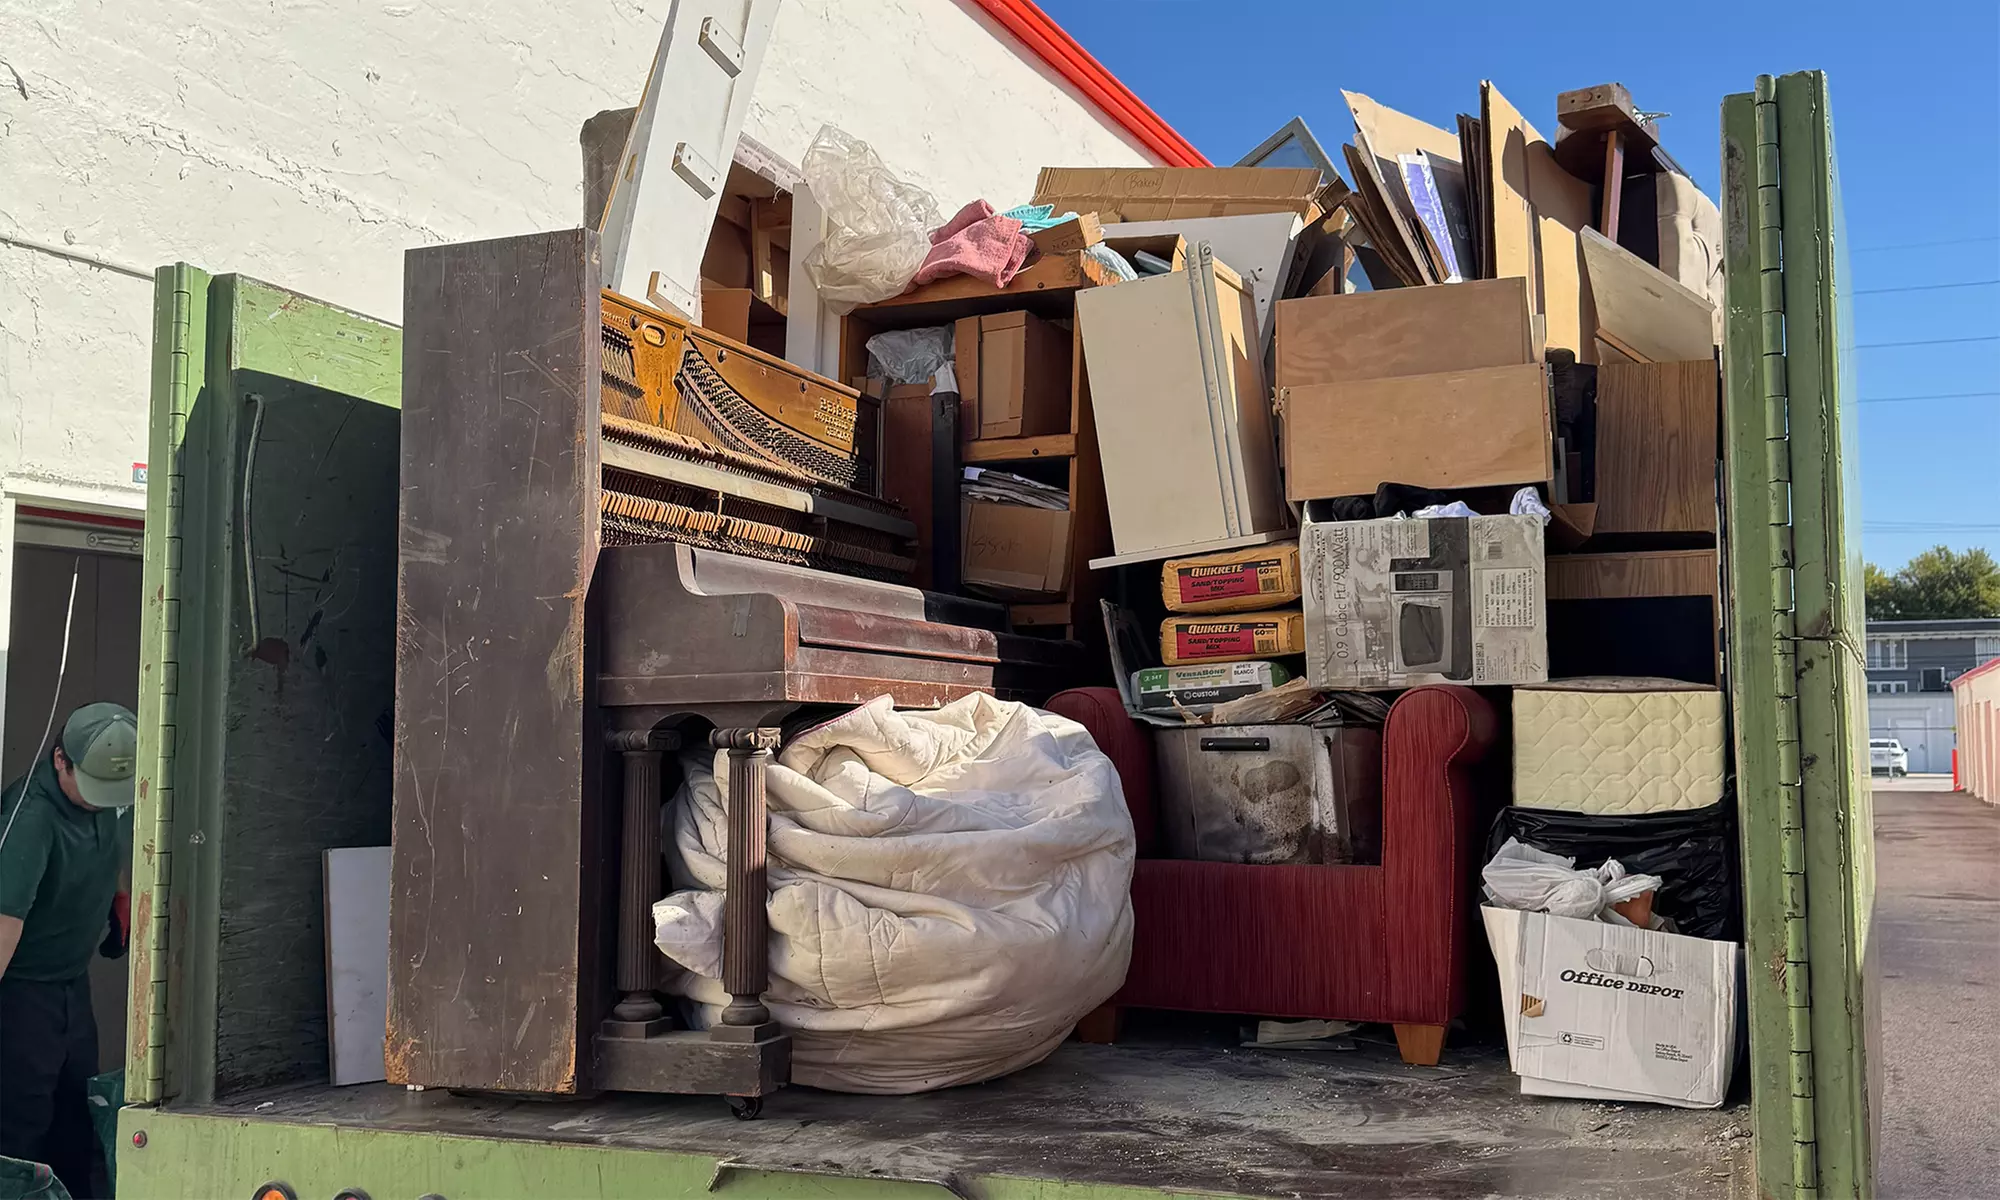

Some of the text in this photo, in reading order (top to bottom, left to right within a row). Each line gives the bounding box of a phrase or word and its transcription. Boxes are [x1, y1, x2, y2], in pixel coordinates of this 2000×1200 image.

[1191, 563, 1244, 578] QUIKRETE
[1259, 567, 1269, 575] 60
[1191, 577, 1244, 587] SAND/TOPPING
[1334, 603, 1349, 637] Cubic
[1188, 623, 1240, 635] QUIKRETE
[1188, 637, 1240, 645] SAND/TOPPING
[1336, 641, 1349, 659] 0.9
[1192, 690, 1220, 699] CUSTOM
[1560, 969, 1684, 999] Office DEPOT
